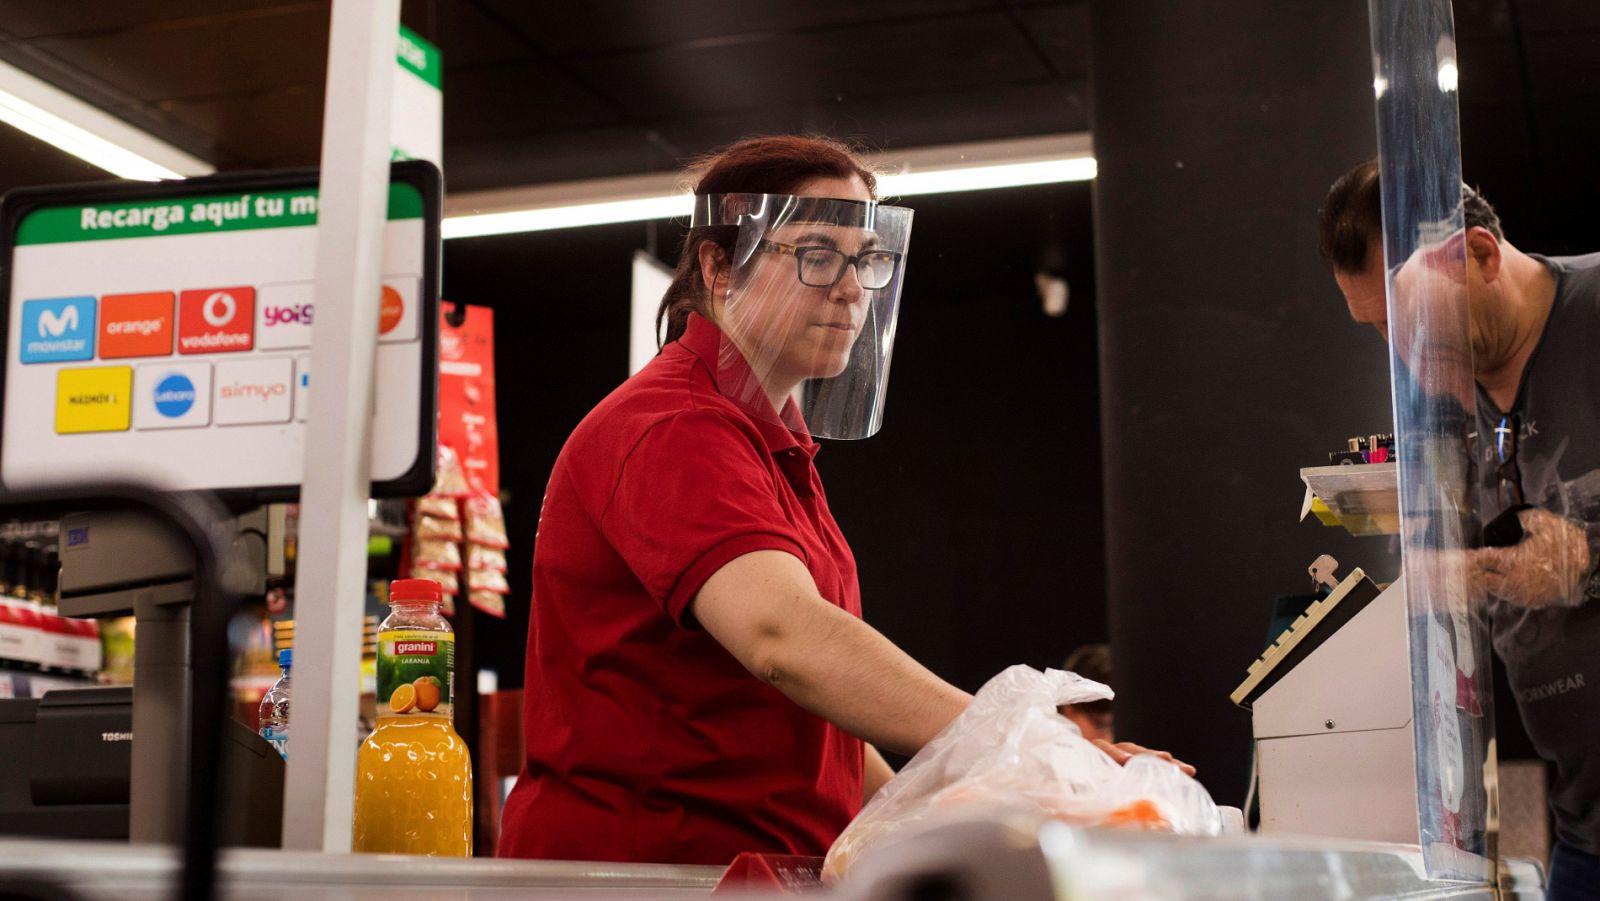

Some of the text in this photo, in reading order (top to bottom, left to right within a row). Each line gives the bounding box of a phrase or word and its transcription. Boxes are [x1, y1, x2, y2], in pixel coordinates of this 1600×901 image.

[80, 194, 319, 230] Recarga aquí tu m
[264, 304, 314, 327] yoig
[106, 319, 163, 336] orange
[27, 338, 86, 354] movistar
[181, 331, 250, 348] vodafone
[221, 382, 286, 401] simyo
[397, 642, 434, 654] granini
